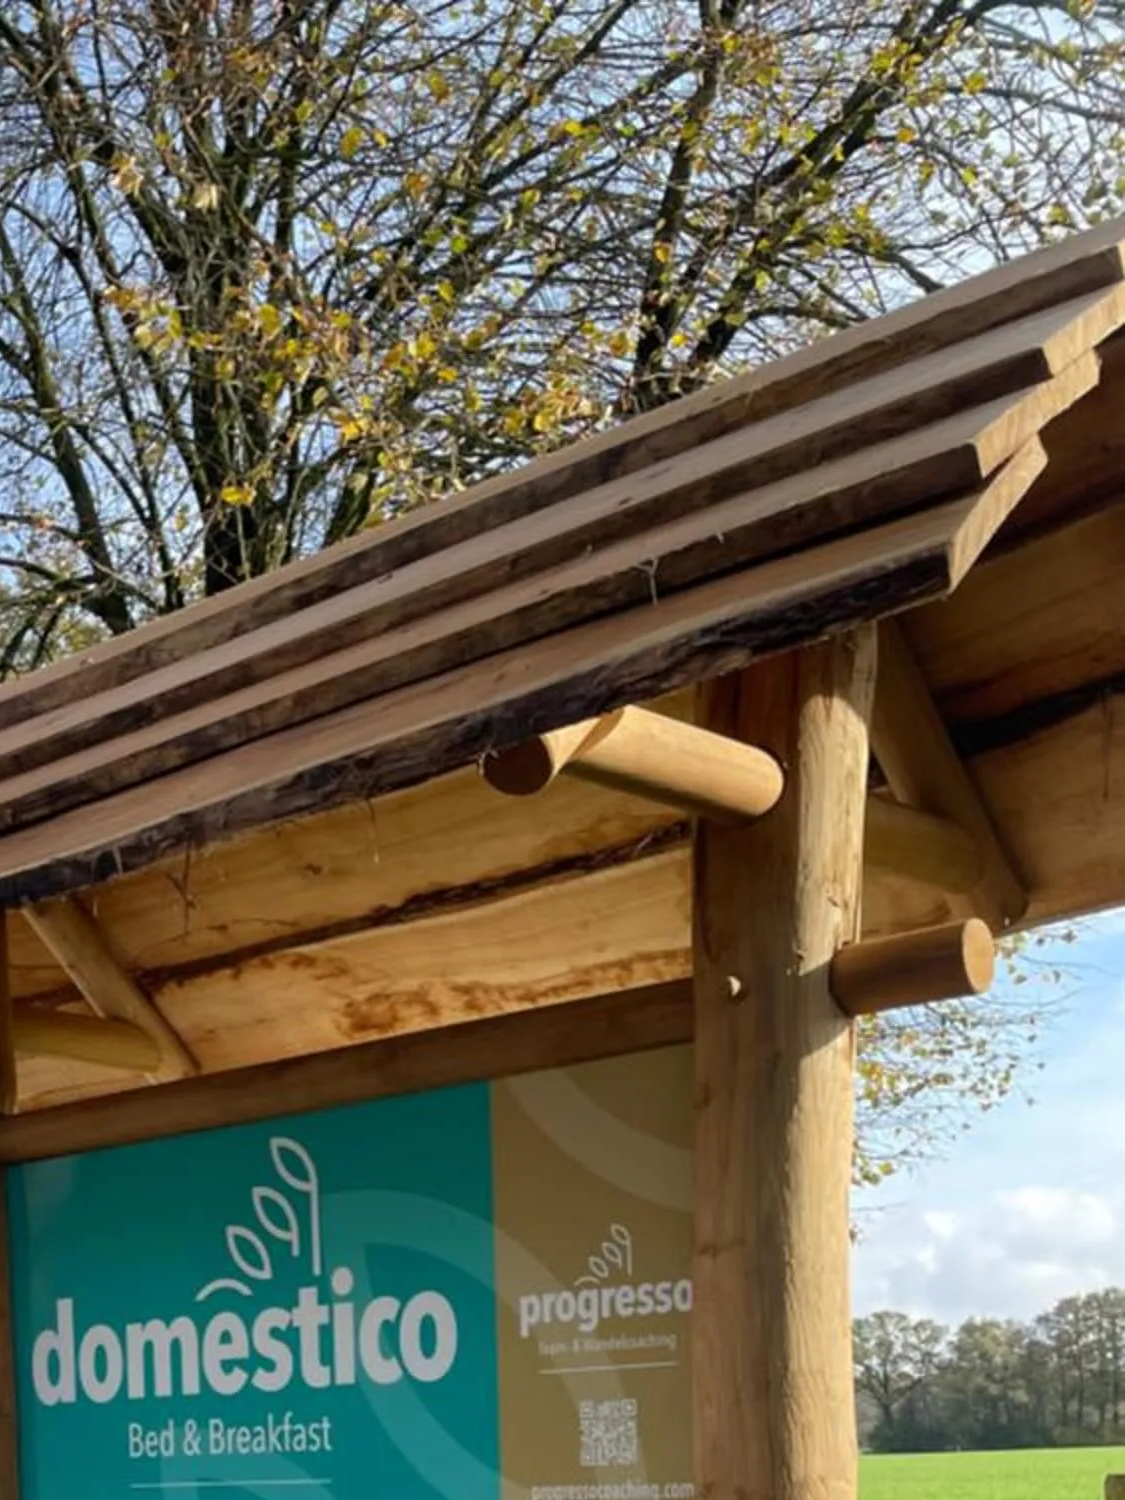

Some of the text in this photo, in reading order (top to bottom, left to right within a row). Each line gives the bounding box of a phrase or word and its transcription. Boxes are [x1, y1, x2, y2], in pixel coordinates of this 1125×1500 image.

[32, 1267, 457, 1406] domestico
[519, 1279, 692, 1338] progresso
[128, 1412, 332, 1458] Bed & Breakfast
